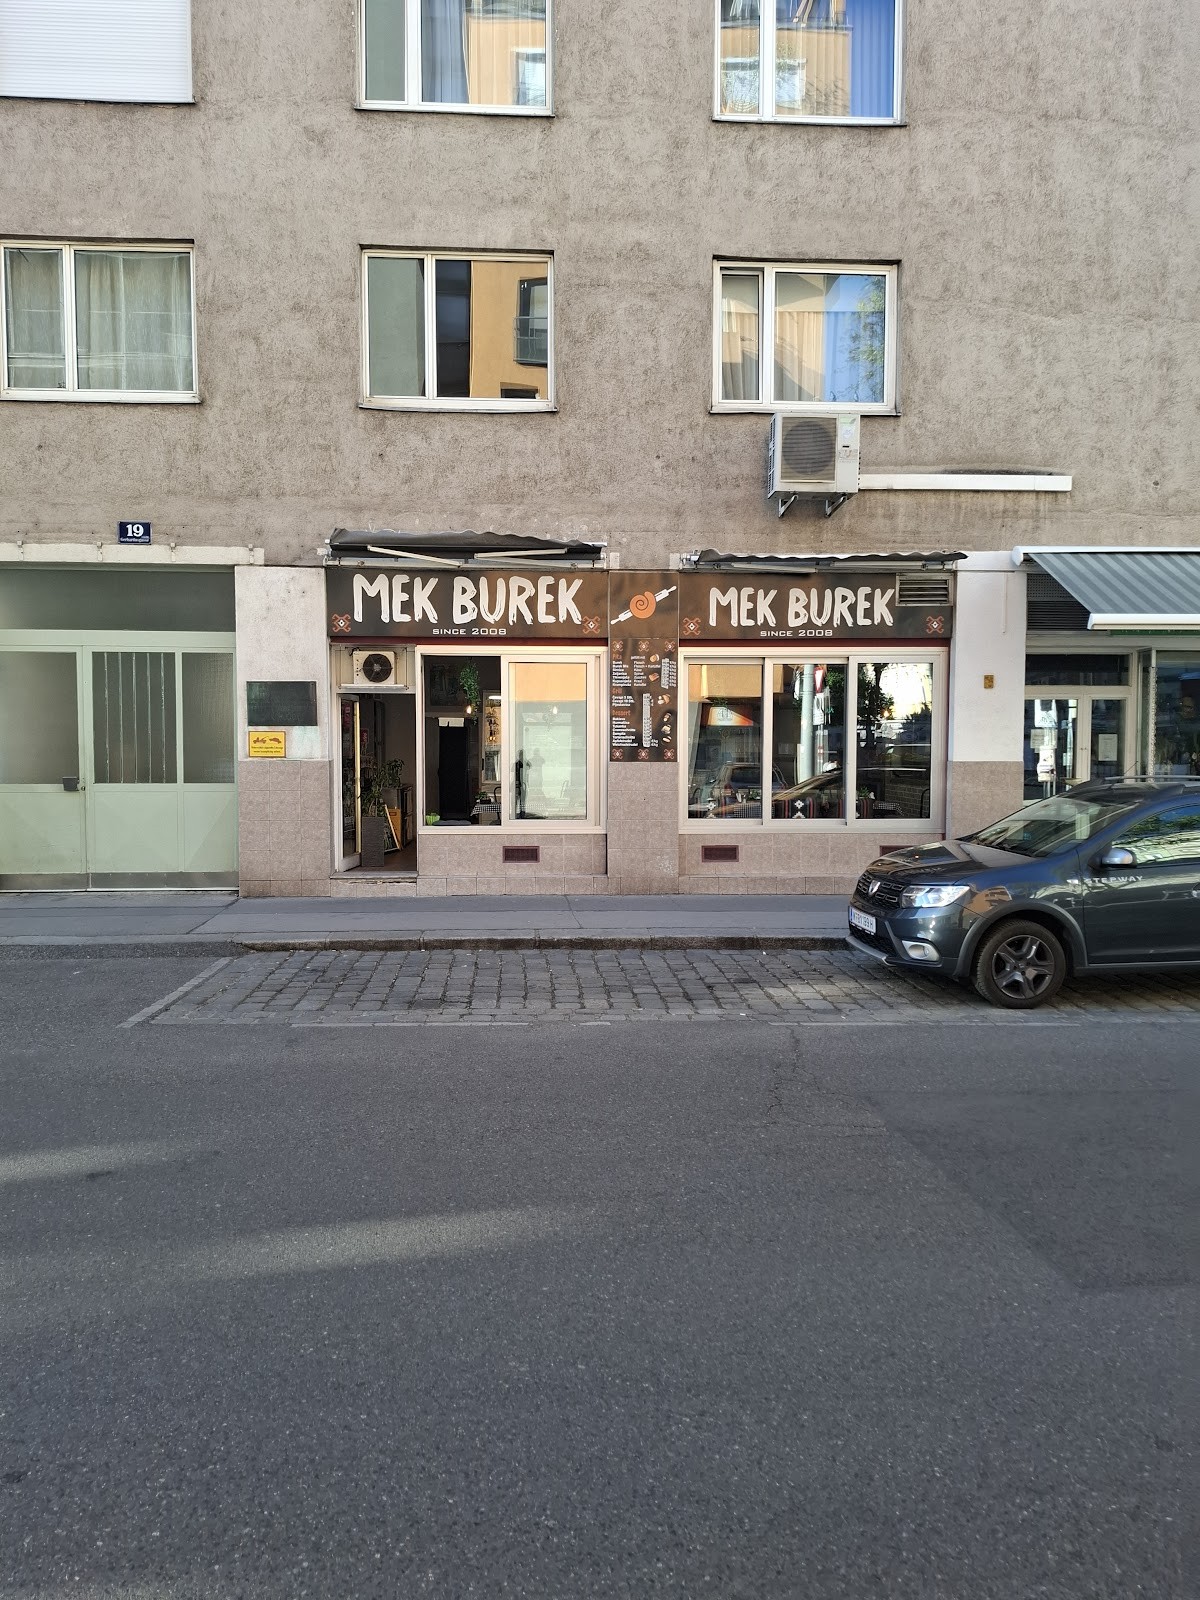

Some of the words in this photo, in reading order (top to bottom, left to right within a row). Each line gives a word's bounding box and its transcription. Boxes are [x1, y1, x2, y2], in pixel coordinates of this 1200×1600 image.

[126, 524, 144, 537] 19
[353, 573, 439, 623] MEK
[453, 575, 583, 625] BUREK
[709, 587, 778, 627] MEK
[788, 587, 895, 627] BUREK
[798, 629, 833, 637] 2008
[1083, 875, 1143, 884] STEPWAY
